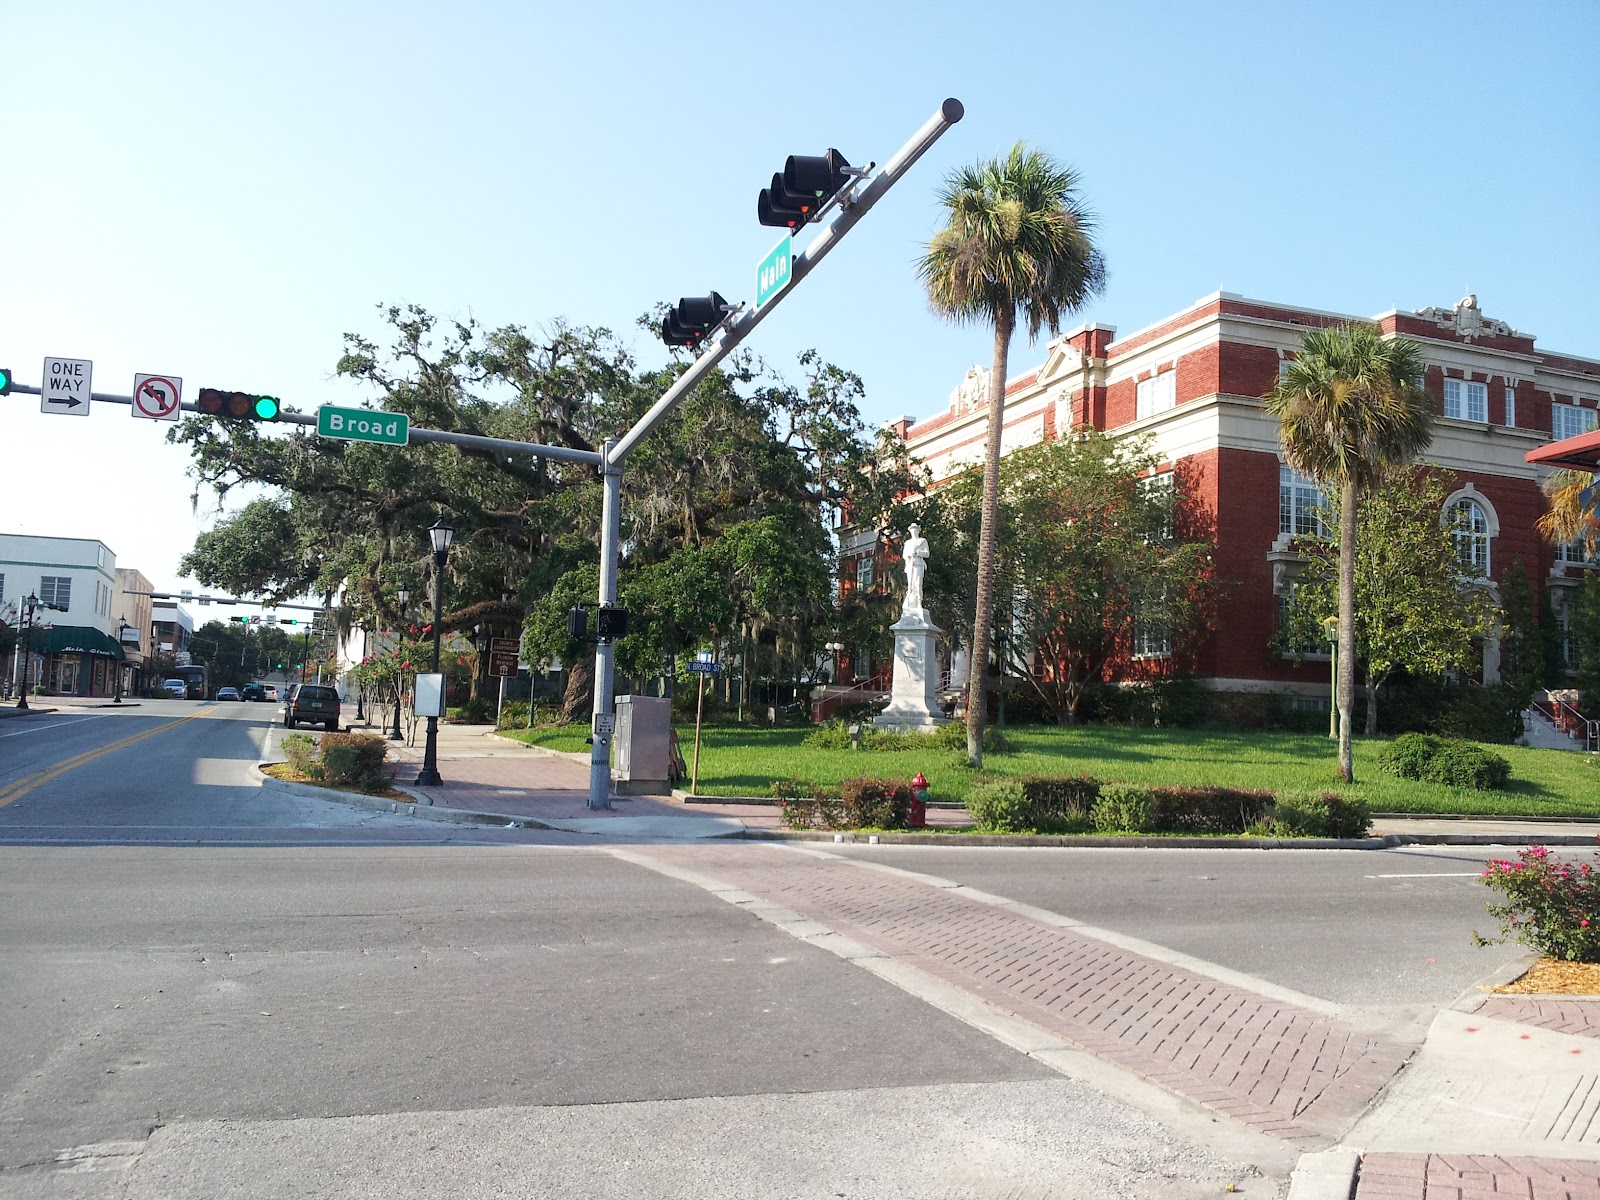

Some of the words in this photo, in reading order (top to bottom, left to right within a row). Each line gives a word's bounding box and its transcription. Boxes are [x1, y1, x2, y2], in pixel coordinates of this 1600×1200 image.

[760, 255, 787, 295] Main
[52, 362, 83, 376] ONE
[50, 378, 84, 391] WAY
[330, 414, 397, 437] Broad
[692, 663, 711, 671] BROAD
